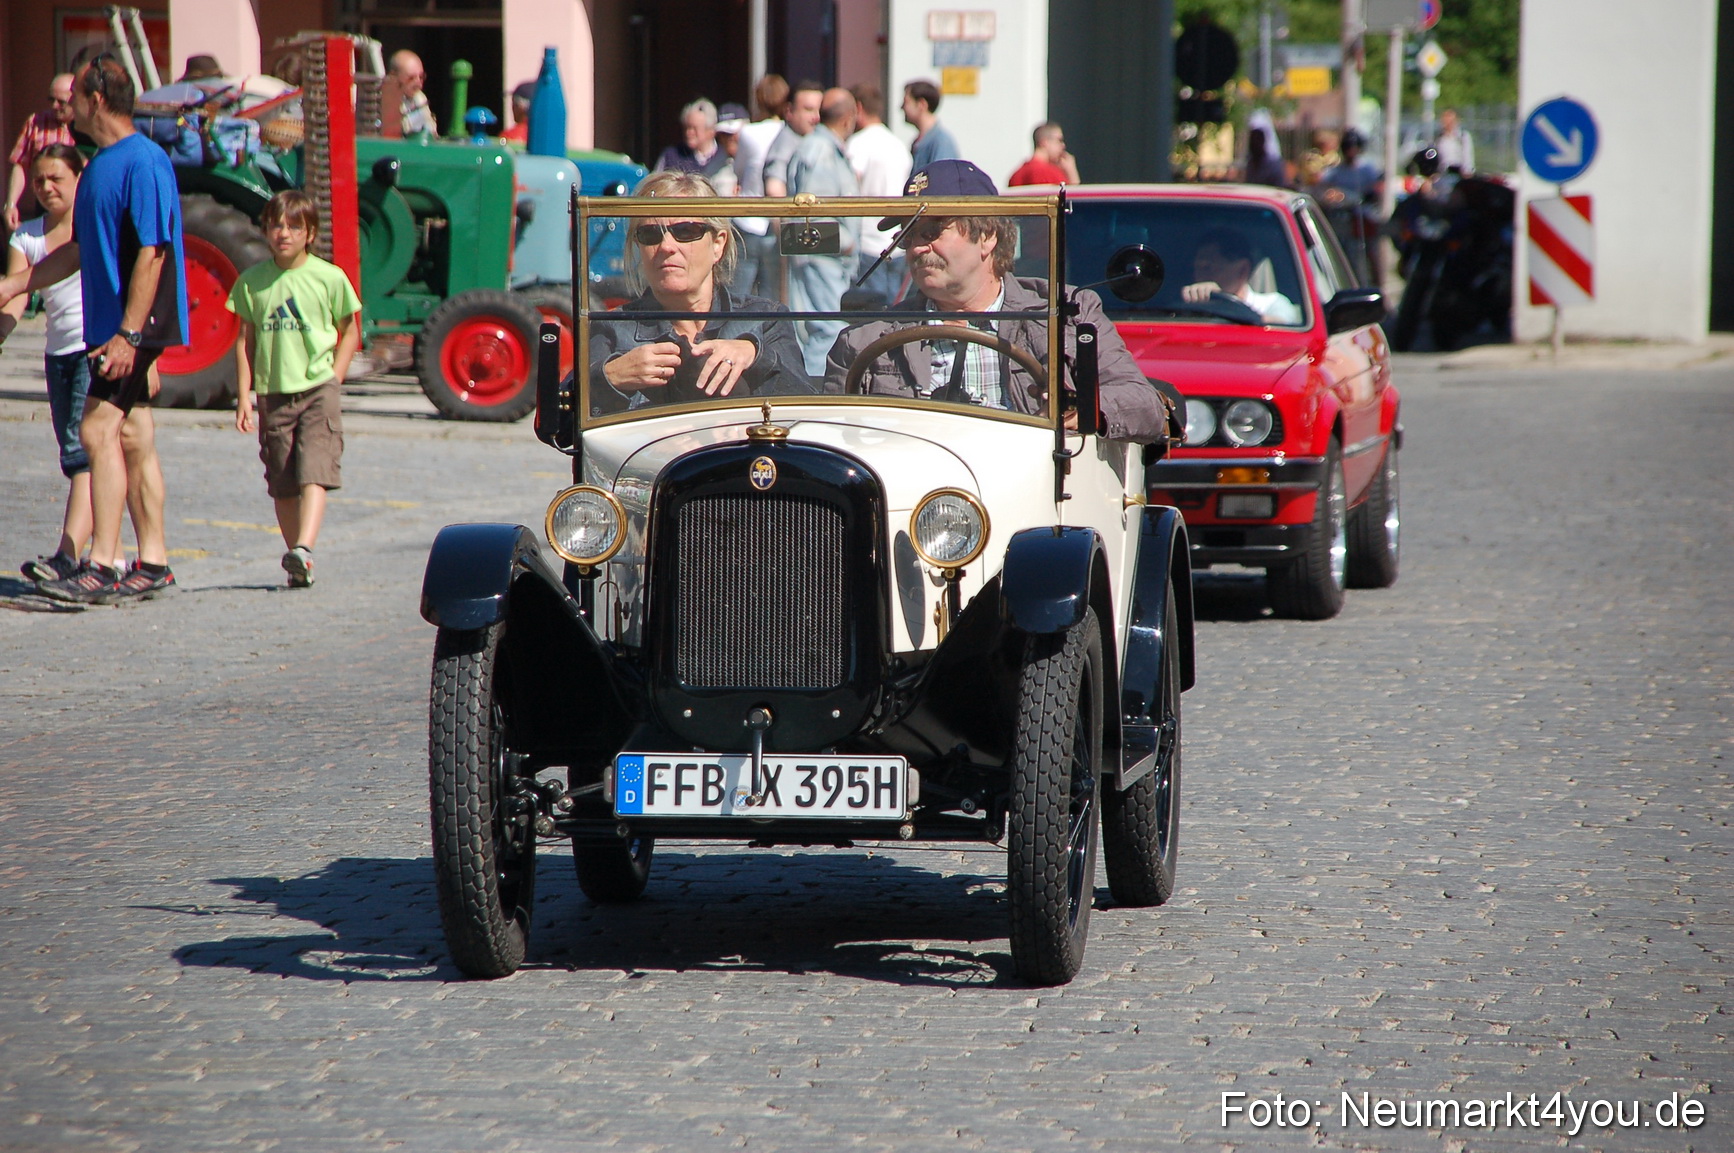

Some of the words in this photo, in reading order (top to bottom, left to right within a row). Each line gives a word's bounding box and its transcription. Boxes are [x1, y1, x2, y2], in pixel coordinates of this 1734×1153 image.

[262, 319, 311, 332] adidas
[647, 763, 725, 807] FFB
[795, 764, 898, 809] 395H
[625, 790, 636, 803] D
